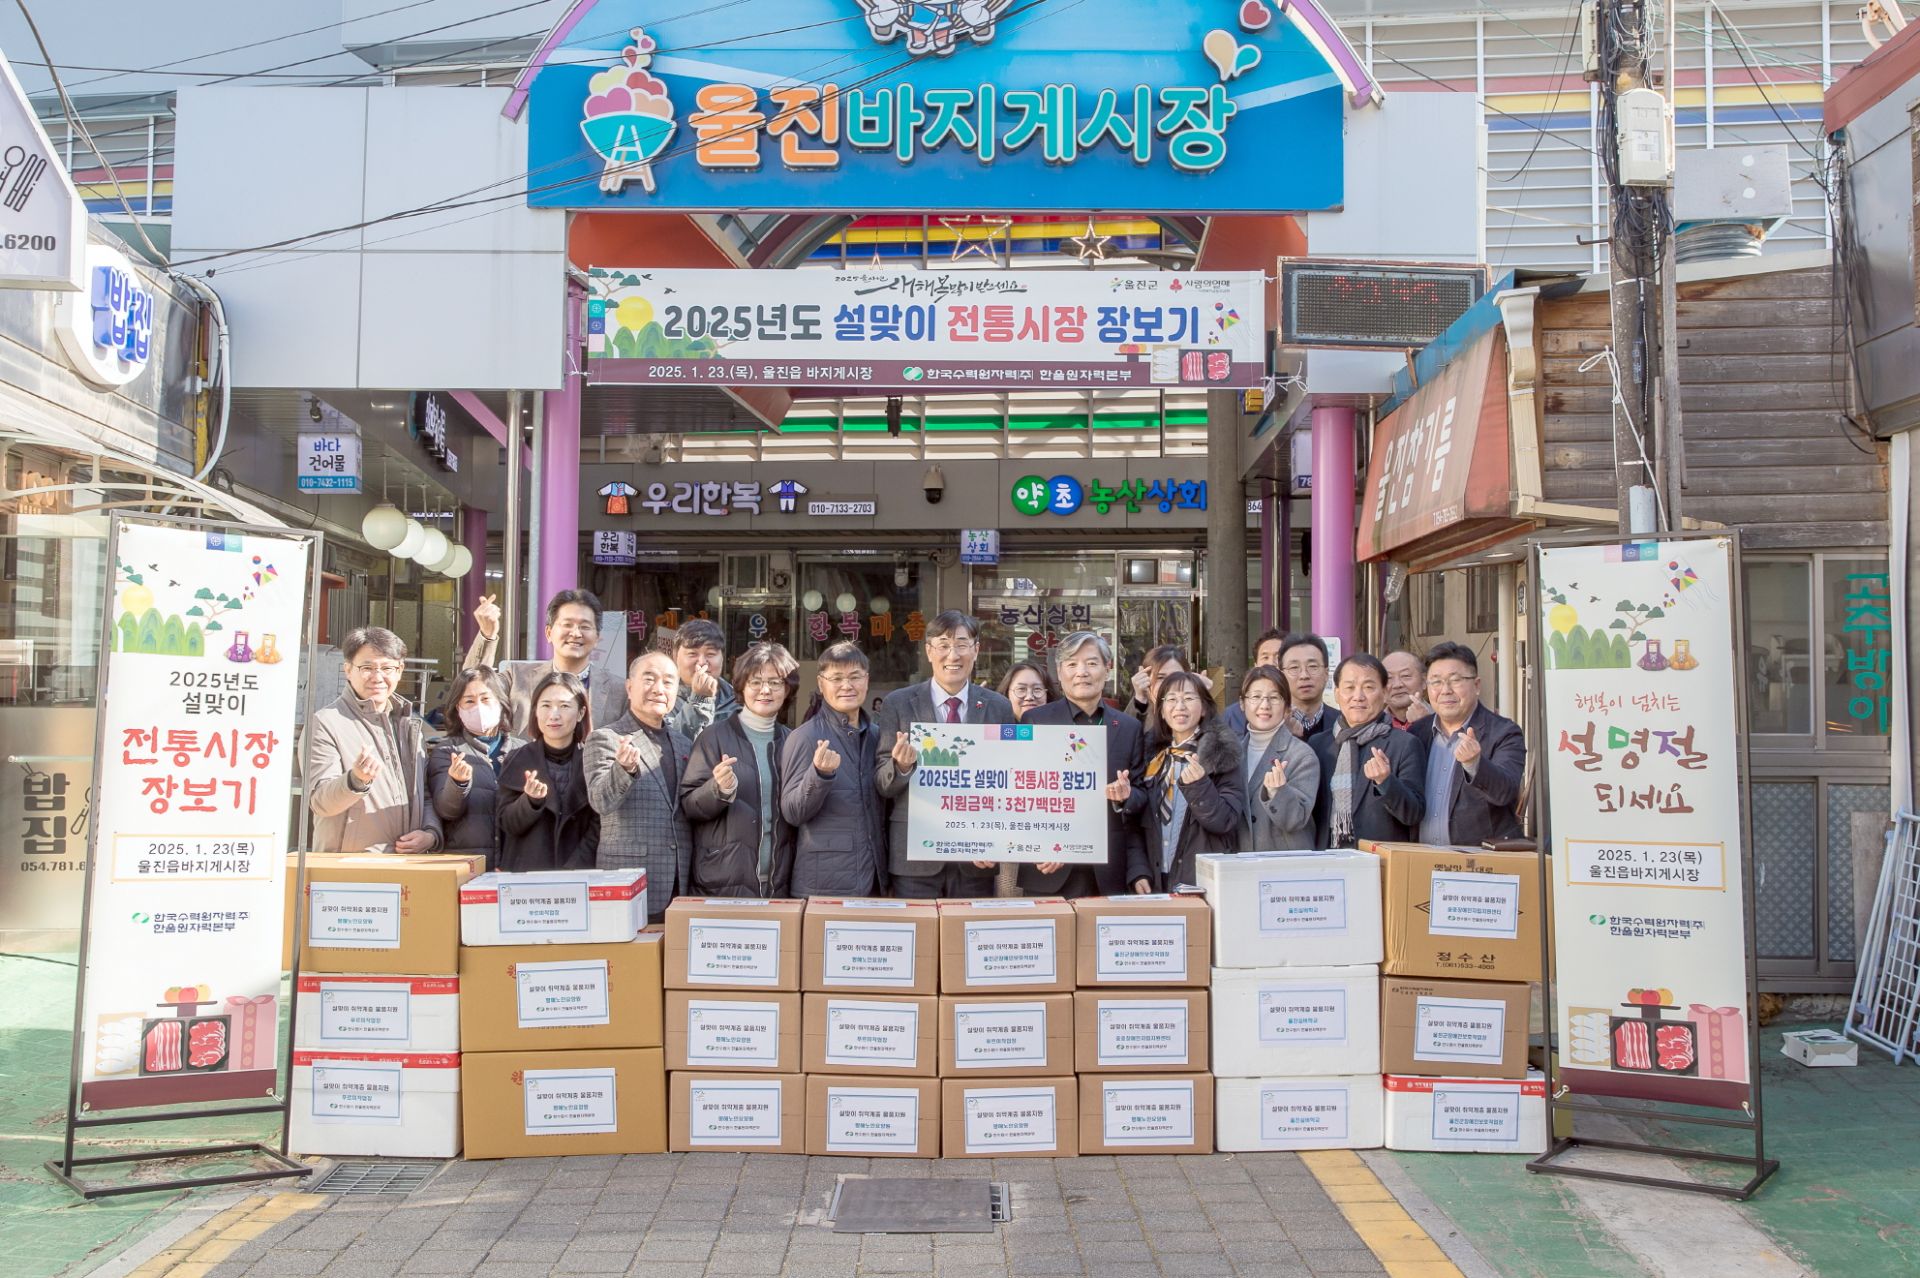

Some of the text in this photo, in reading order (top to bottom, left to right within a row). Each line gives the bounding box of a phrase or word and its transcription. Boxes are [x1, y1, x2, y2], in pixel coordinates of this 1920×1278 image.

[688, 82, 1238, 172] 울진바지게시장
[1123, 279, 1159, 291] 울진군
[663, 303, 1200, 345] 2025년도 설맞이 전통시장 장보기
[648, 365, 687, 379] 2025.
[691, 366, 704, 379] 1.
[762, 364, 803, 380] 울진읍
[806, 365, 873, 381] 바지게시장
[1039, 368, 1132, 382] 한울원자력본부
[313, 437, 341, 452] 바다
[309, 454, 345, 472] 건어물
[300, 477, 354, 488] 010-7432-1115
[641, 480, 763, 516] 우리한복
[1016, 478, 1208, 515] 약초 농산상회
[810, 503, 873, 514] 010-7133-2703
[600, 531, 620, 543] 우리
[967, 530, 990, 541] 농산
[600, 542, 620, 554] 한복
[967, 541, 989, 554] 상회
[1000, 604, 1091, 626] 농산상회
[169, 671, 260, 692] 2025년도
[182, 691, 246, 716] 설맞이
[1574, 692, 1681, 716] 행복이 넘치는
[122, 725, 279, 769] 전통시장
[919, 768, 971, 789] 2025년도
[974, 769, 1008, 790] 설맞이
[1062, 771, 1097, 791] 장보기
[141, 774, 257, 815] 장보기
[1594, 782, 1695, 814] 되세요
[940, 795, 994, 812] 지원금액
[1005, 796, 1076, 814] 3천7백만원
[945, 821, 967, 830] 2025.
[1033, 822, 1070, 832] 바지게시장
[148, 842, 255, 857] 2025. 1. 23(목)
[1597, 848, 1703, 865] 2025. 1. 23(목)
[153, 922, 236, 934] 한울원자력본부
[1609, 925, 1691, 939] 한울원자력본부
